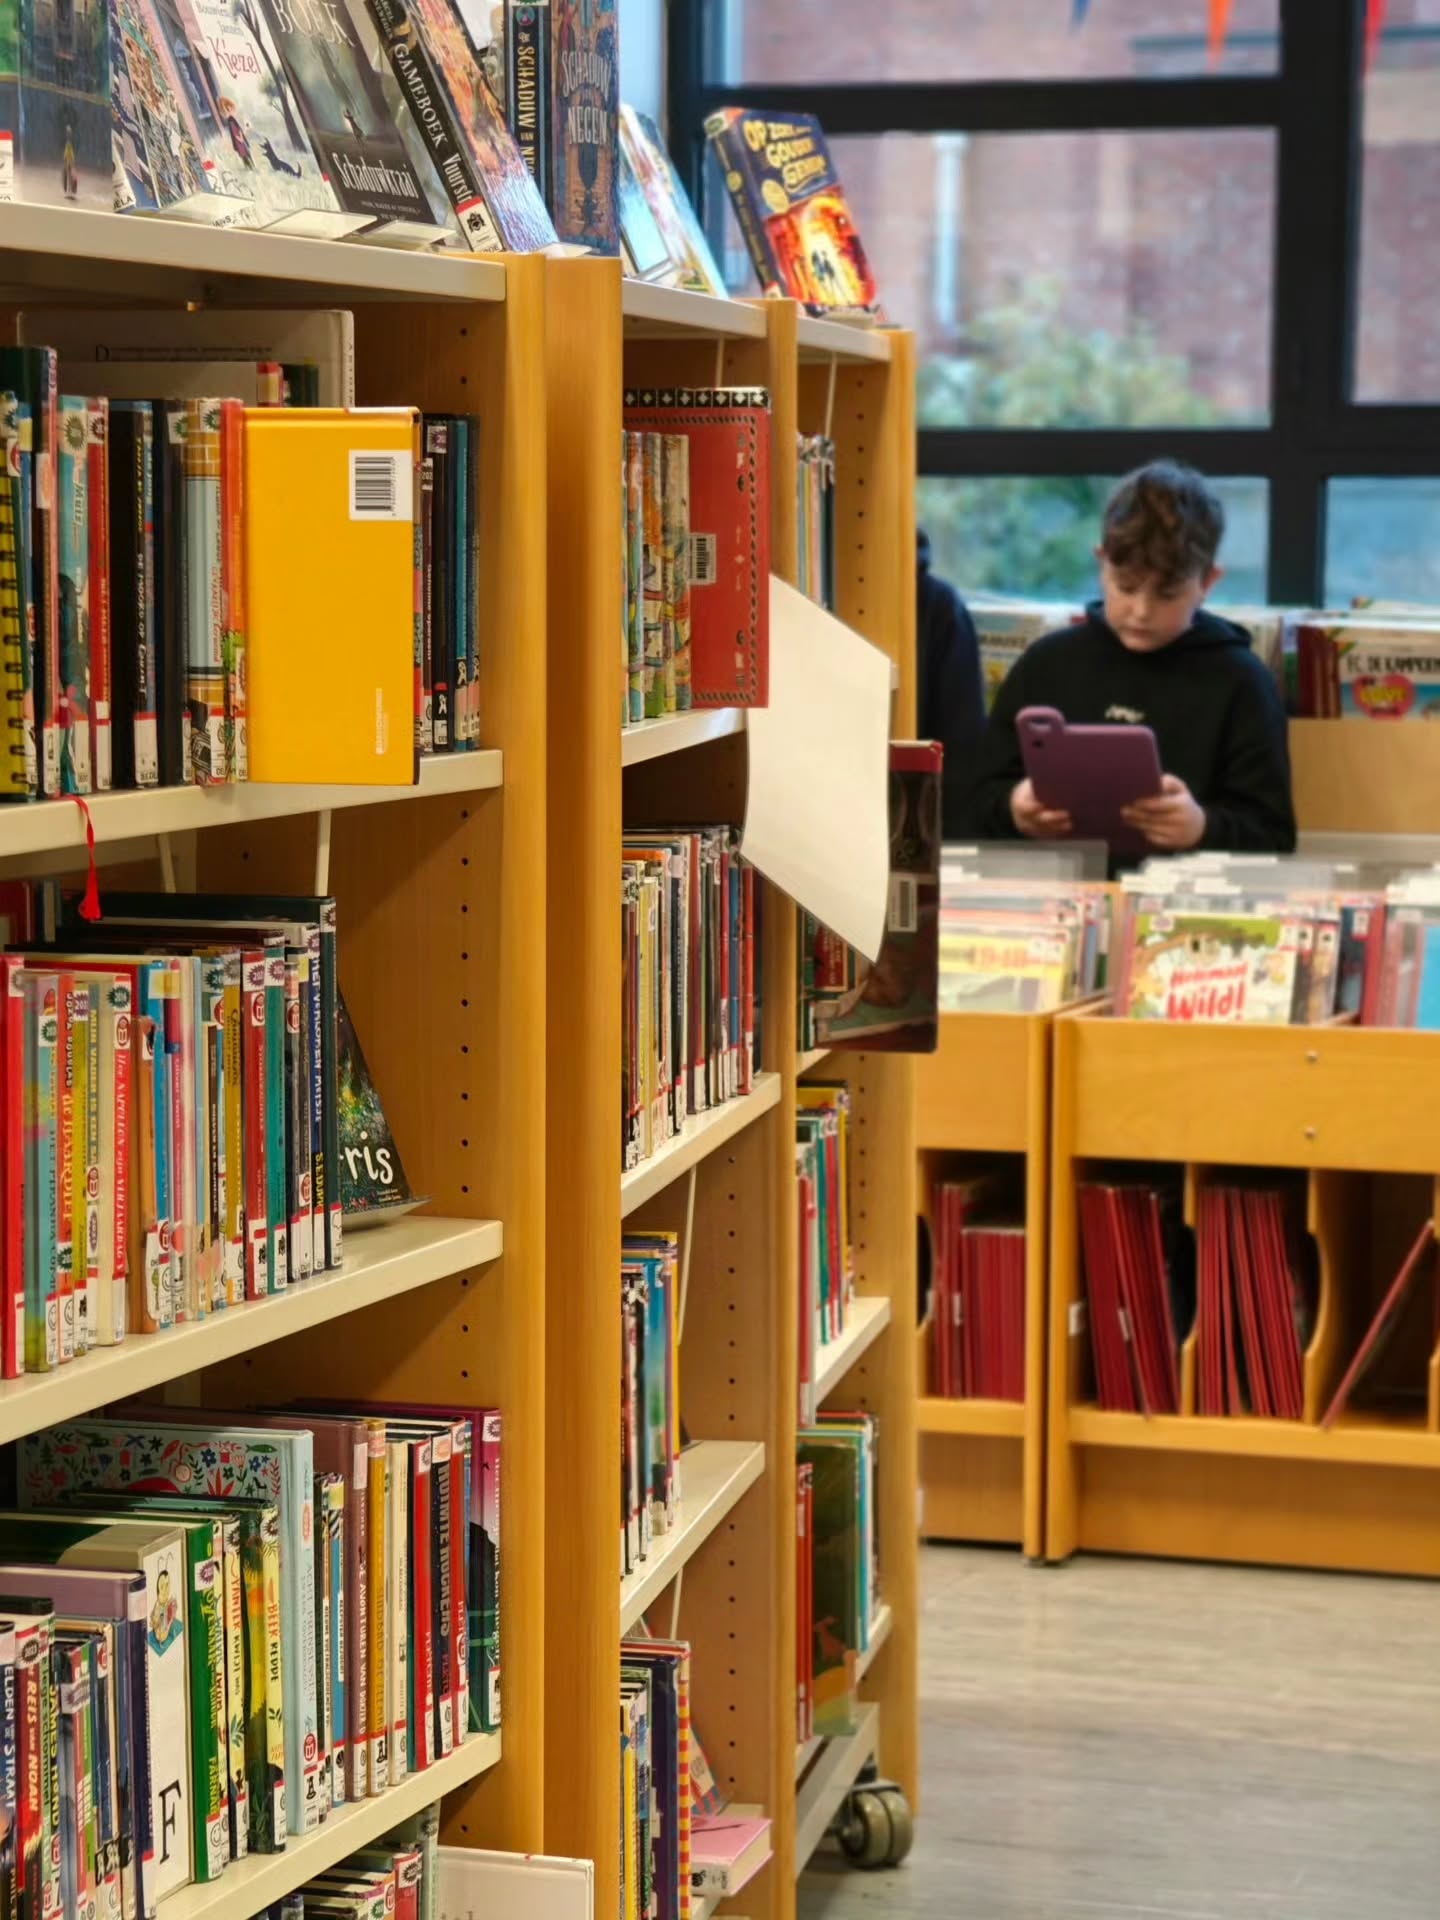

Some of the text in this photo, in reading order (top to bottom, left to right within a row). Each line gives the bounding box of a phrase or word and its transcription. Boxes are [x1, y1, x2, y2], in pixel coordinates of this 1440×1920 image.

[206, 36, 263, 79] Kiezel
[561, 51, 613, 98] SCHADUW
[394, 43, 448, 149] GAMEBOEK
[517, 46, 536, 129] SCHADUW
[567, 105, 609, 145] NEGEN
[332, 152, 420, 200] Schaduwkraai
[1167, 979, 1245, 1022] Wild!
[117, 1081, 126, 1146] NAPOLEON
[340, 1131, 394, 1185] ris
[116, 1178, 125, 1259] VERJAARDAG
[267, 1603, 280, 1638] BEER
[359, 1583, 367, 1658] AVONTUREN
[26, 1679, 38, 1725] REIS
[359, 1663, 367, 1687] VAN
[49, 1685, 59, 1759] JAMES
[5, 1743, 16, 1810] STRAAT
[42, 1717, 50, 1806] schommel
[159, 1780, 182, 1864] F
